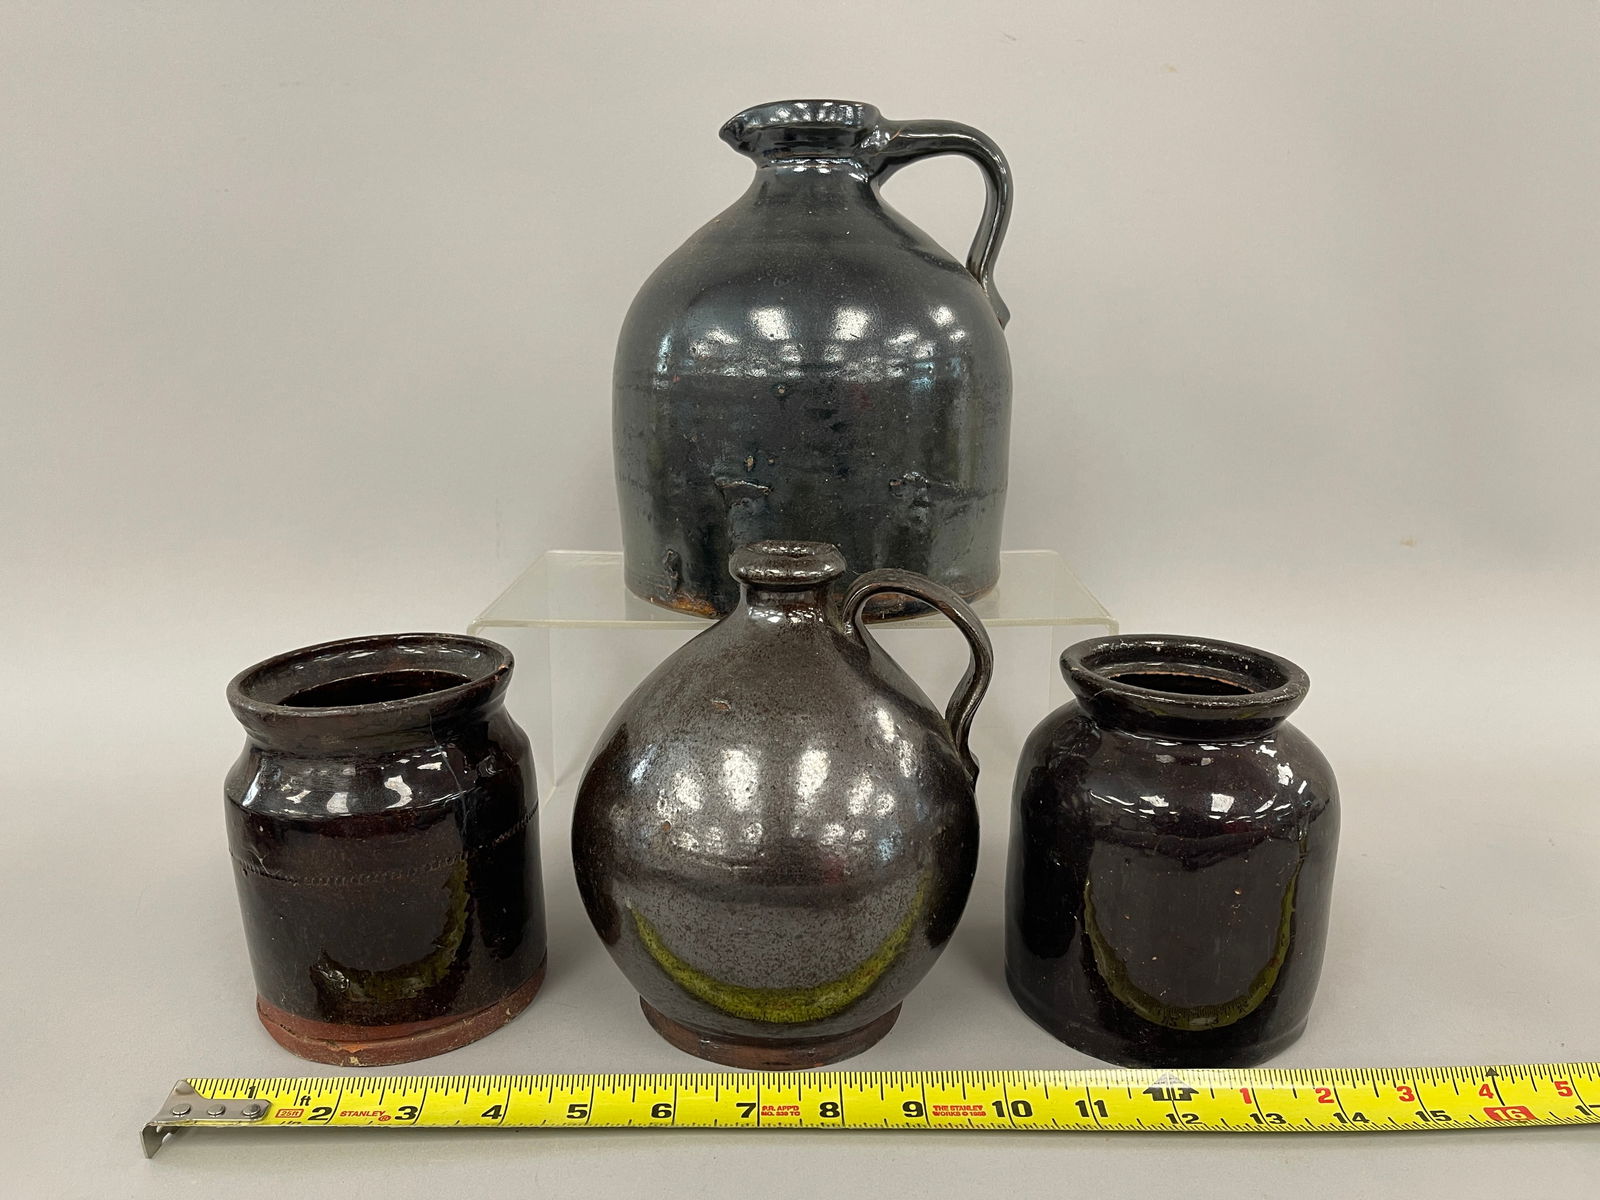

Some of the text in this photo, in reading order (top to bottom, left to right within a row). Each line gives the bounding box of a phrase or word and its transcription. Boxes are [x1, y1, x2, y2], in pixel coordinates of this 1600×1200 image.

[1240, 1087, 1252, 1104] 1
[1315, 1087, 1334, 1103] 2
[1396, 1086, 1415, 1102] 3
[1478, 1083, 1494, 1099] 4
[1554, 1080, 1573, 1097] 5
[308, 1106, 333, 1121] 2
[395, 1105, 418, 1120] 3
[481, 1104, 502, 1119] 4
[566, 1103, 588, 1119] 5
[651, 1103, 672, 1119] 6
[736, 1102, 756, 1118] 7
[819, 1102, 840, 1118] 8
[902, 1101, 924, 1117] 9
[992, 1100, 1033, 1117] 10
[1075, 1100, 1109, 1118] 11
[1415, 1110, 1452, 1122] 15
[1493, 1107, 1523, 1121] 16
[1166, 1113, 1203, 1125] 12
[1250, 1112, 1287, 1125] 13
[1333, 1112, 1370, 1124] 14
